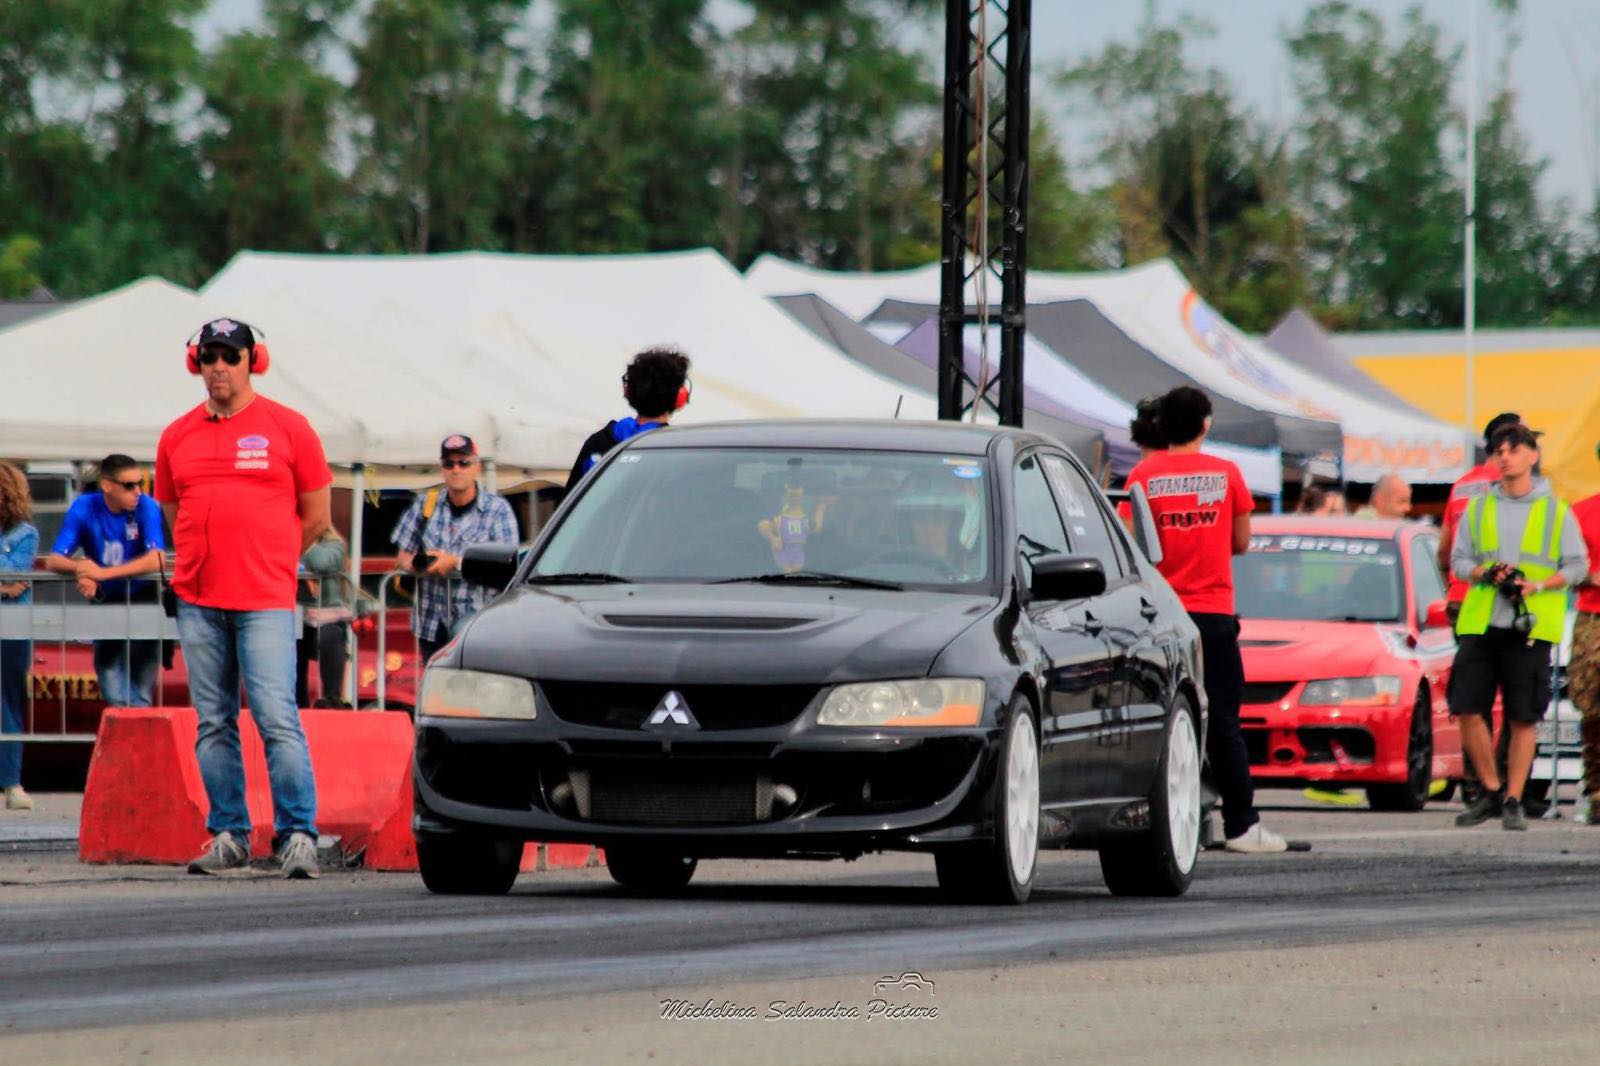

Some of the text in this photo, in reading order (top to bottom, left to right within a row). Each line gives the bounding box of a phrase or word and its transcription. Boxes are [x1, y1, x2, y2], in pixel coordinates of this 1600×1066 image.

[1148, 474, 1227, 497] RIVANAZZANO
[1158, 510, 1217, 529] CREW
[1279, 536, 1380, 555] Garage
